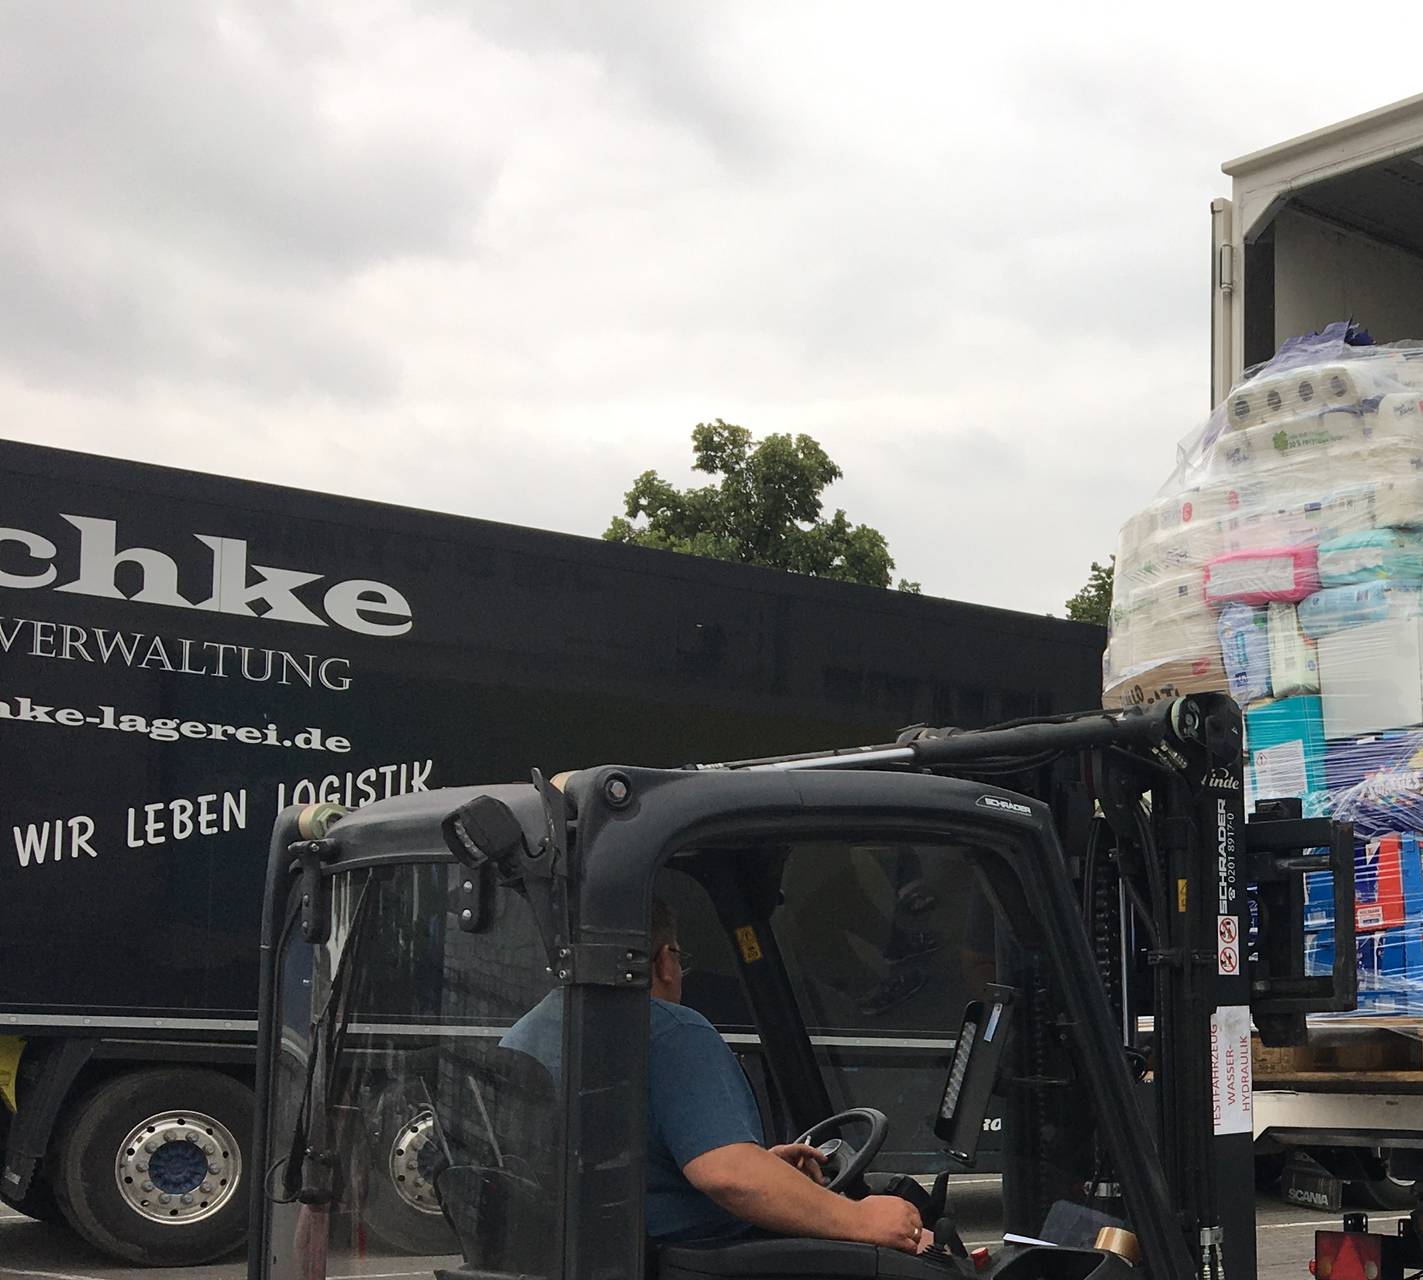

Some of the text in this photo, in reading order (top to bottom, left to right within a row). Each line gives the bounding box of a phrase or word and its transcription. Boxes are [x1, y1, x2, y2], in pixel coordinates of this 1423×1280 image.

[0, 513, 413, 636] chke
[0, 617, 353, 690] VERWALTUNG
[13, 759, 433, 867] WIR LEBEN LOGISTIK
[984, 797, 1032, 814] SCHRADER
[1218, 798, 1228, 915] SCHRADER
[1226, 812, 1236, 883] 0201 8917-0
[1225, 1043, 1236, 1106] WASSER-
[1239, 1035, 1251, 1112] HYDRAULIK
[1288, 1188, 1329, 1206] SCANIA
